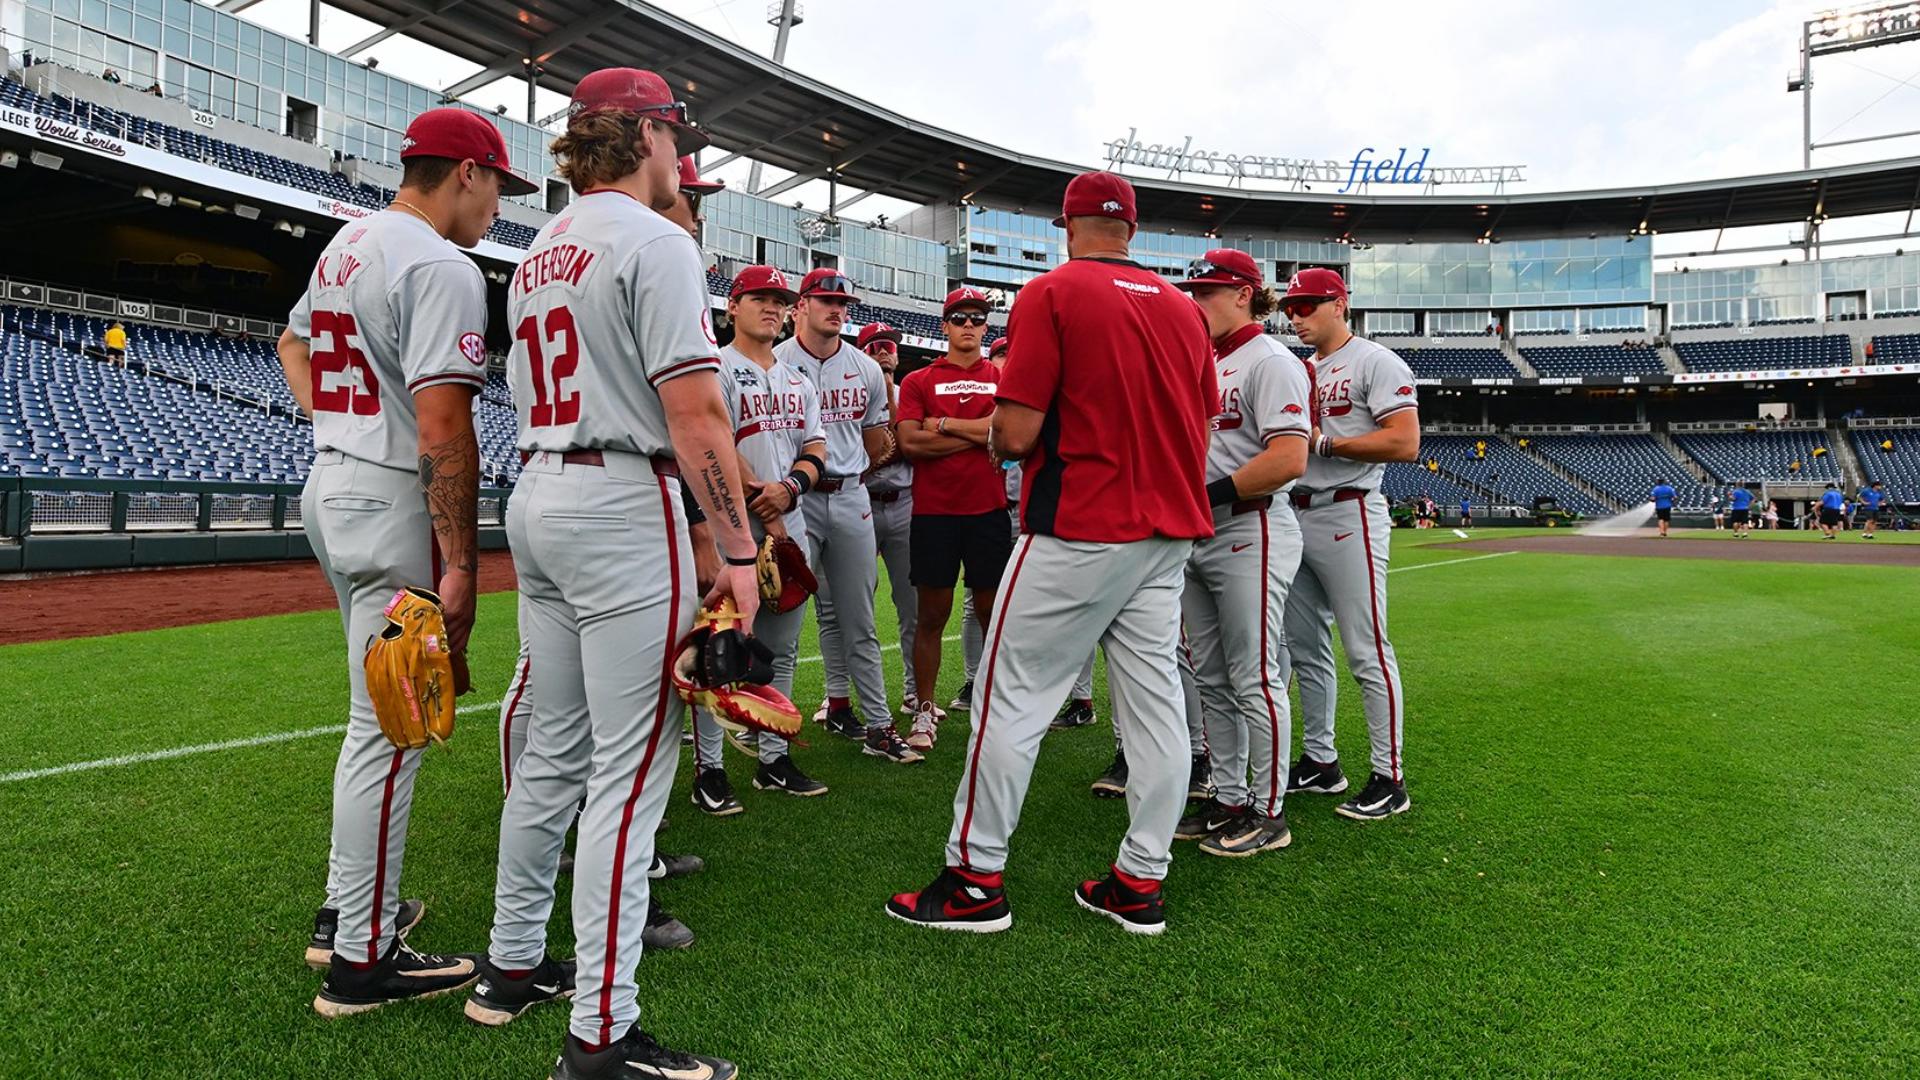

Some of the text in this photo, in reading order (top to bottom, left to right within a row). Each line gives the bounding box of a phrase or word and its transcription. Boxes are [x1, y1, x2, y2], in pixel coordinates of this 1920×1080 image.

[0, 110, 126, 154] LEGE World Series
[194, 112, 214, 125] 205
[1108, 127, 1523, 193] charles SCHWAB field OMAHA
[515, 243, 595, 302] PETERSON
[125, 303, 146, 315] 105
[516, 305, 580, 427] 12
